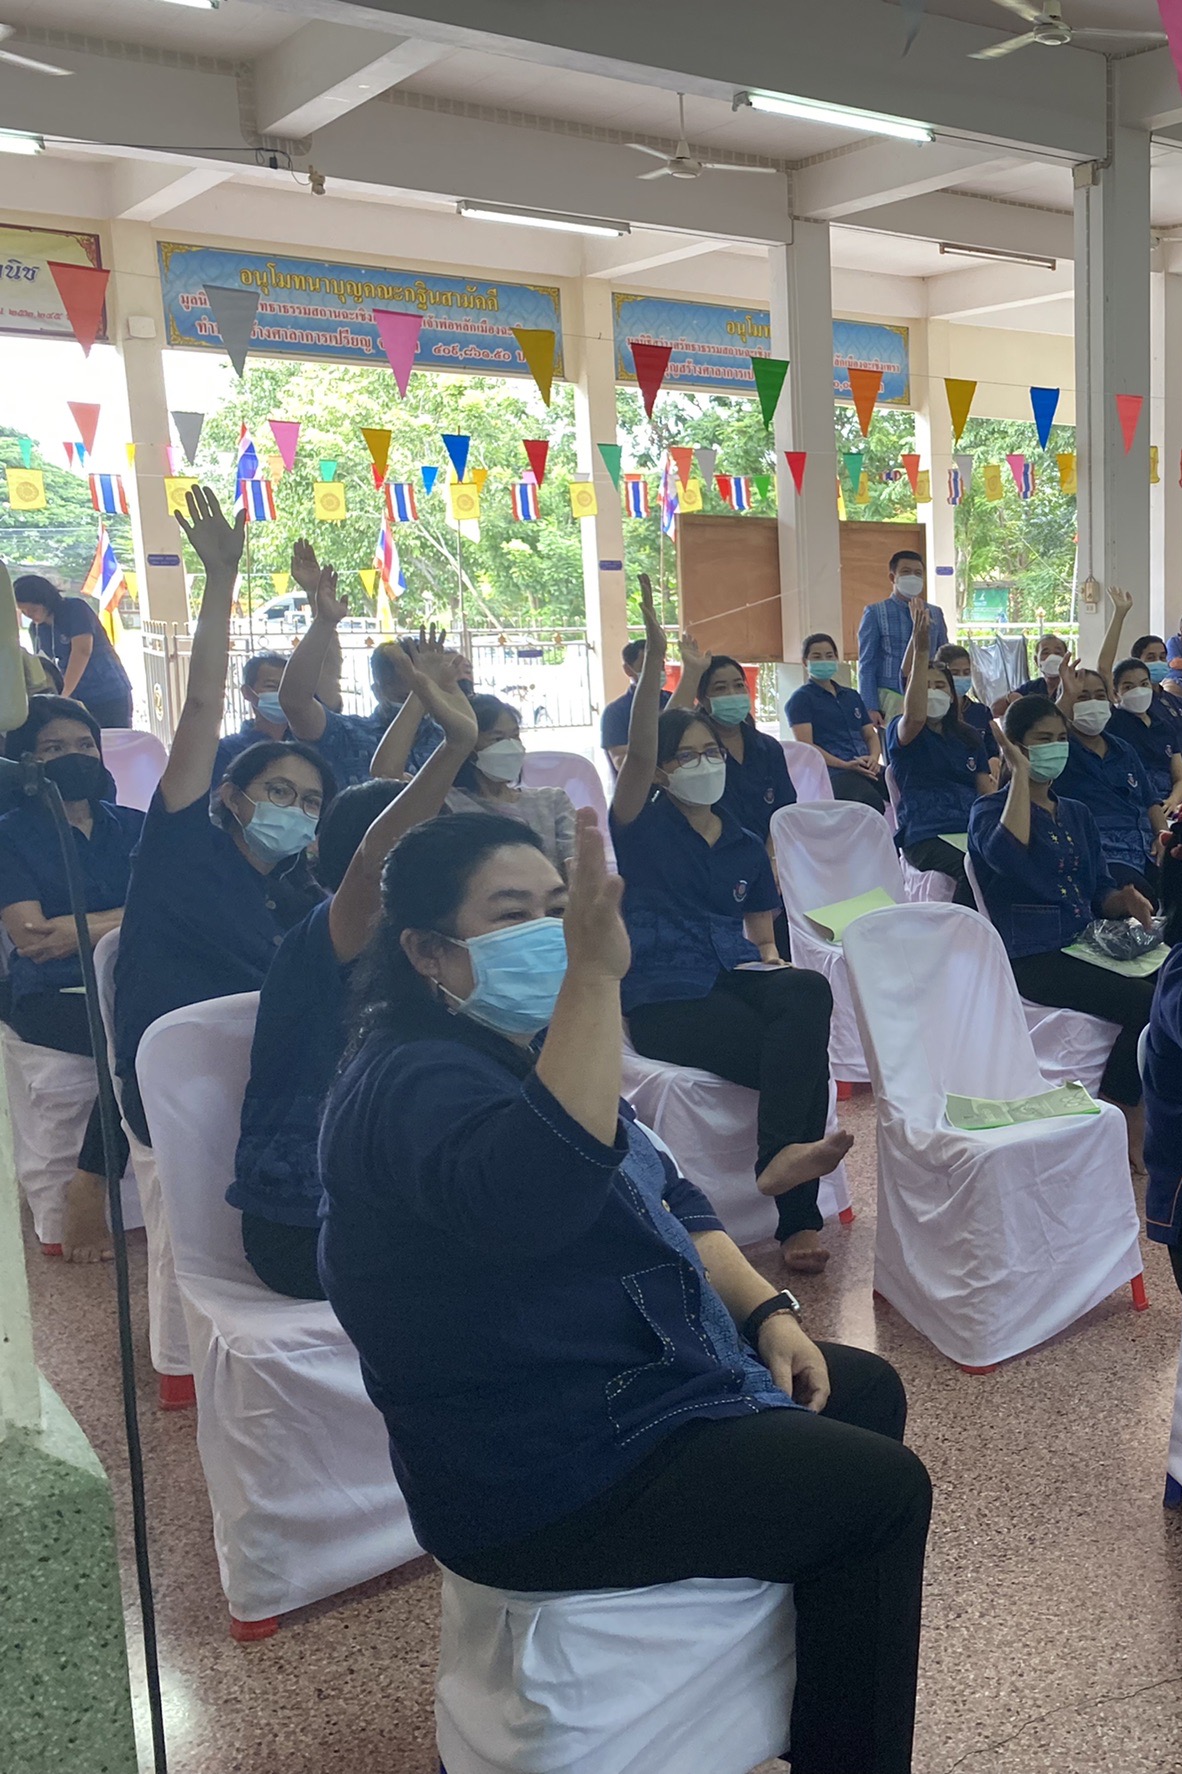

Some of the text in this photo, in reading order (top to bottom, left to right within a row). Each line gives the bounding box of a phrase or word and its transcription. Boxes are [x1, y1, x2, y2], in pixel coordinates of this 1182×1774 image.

[0, 258, 40, 281] นิช
[240, 263, 499, 311] อนุโมทนาบุญคณะกฐินสามัคคี
